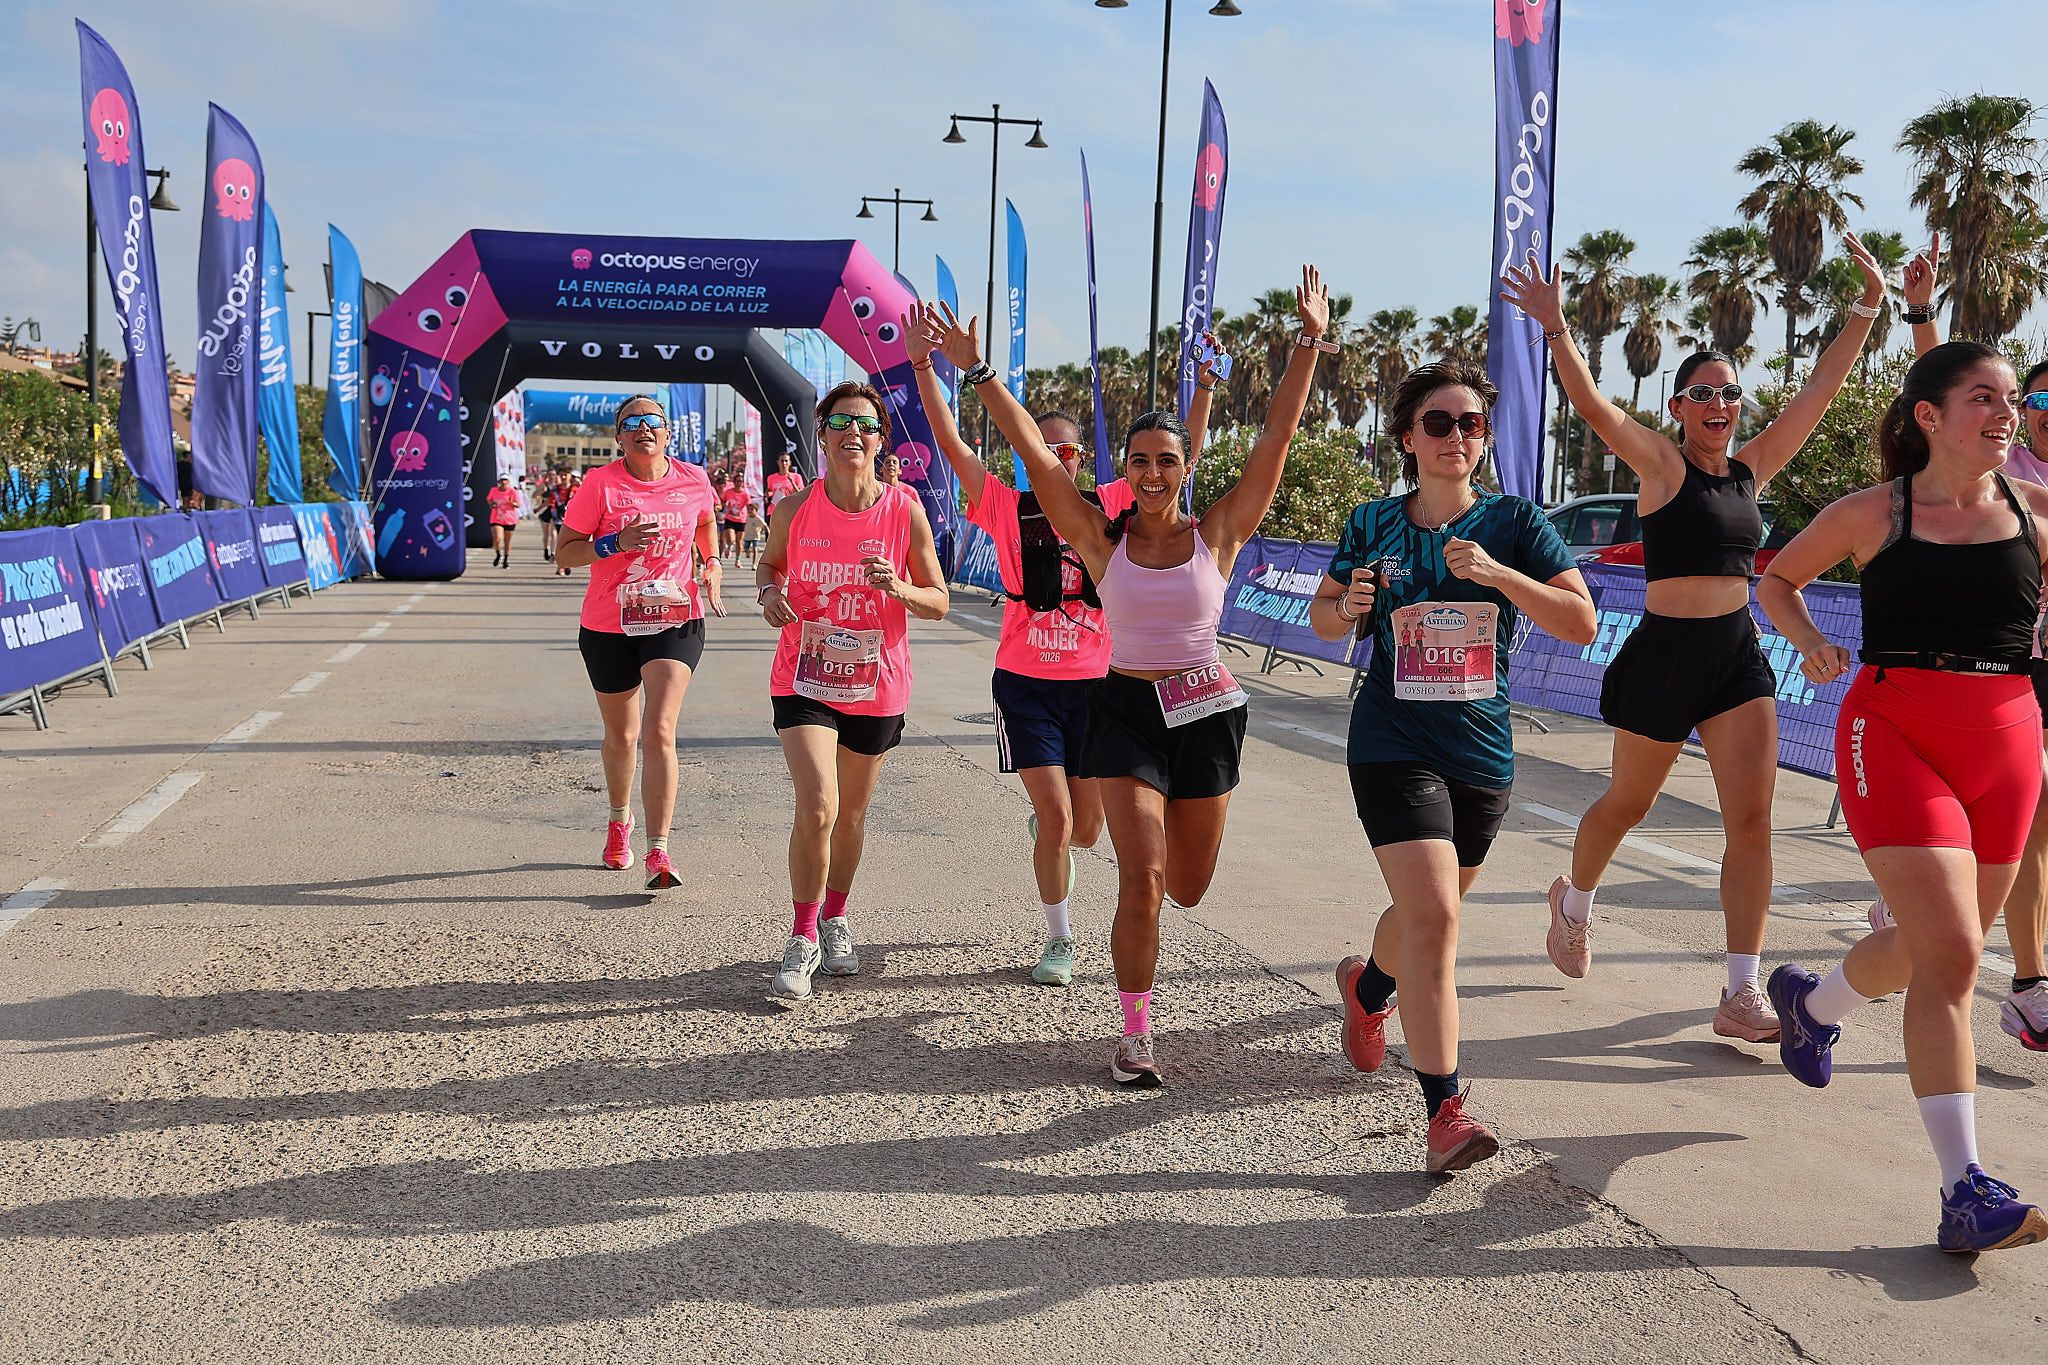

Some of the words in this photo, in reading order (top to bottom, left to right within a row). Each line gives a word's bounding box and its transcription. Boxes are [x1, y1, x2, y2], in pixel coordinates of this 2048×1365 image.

[600, 252, 686, 273] octopus
[688, 256, 760, 278] energy
[558, 279, 579, 292] LA
[582, 279, 652, 295] ENERGÍA
[655, 283, 699, 297] PARA
[703, 285, 767, 298] CORRER
[556, 296, 568, 307] A
[572, 297, 592, 308] LA
[597, 298, 687, 312] VELOCIDAD
[690, 301, 712, 313] DE
[714, 302, 735, 313] LA
[738, 302, 769, 313] LUZ
[540, 340, 715, 361] VOLVO
[800, 538, 831, 548] OYSHO
[801, 560, 870, 586] CARRER
[644, 605, 670, 615] 016
[1051, 609, 1069, 629] LA
[1425, 616, 1467, 626] ASTURIANA
[828, 637, 860, 648] ASTURIANA
[1026, 627, 1079, 651] MUJER
[1040, 651, 1061, 662] 2026
[1425, 647, 1466, 664] 016
[823, 661, 855, 675] 016
[1438, 666, 1453, 674] 606
[1975, 661, 2010, 672] KIPRUN
[1186, 666, 1220, 688] 016
[802, 686, 829, 697] OYSHO
[1404, 686, 1436, 695] OYSHO
[1176, 706, 1206, 721] OYSHO
